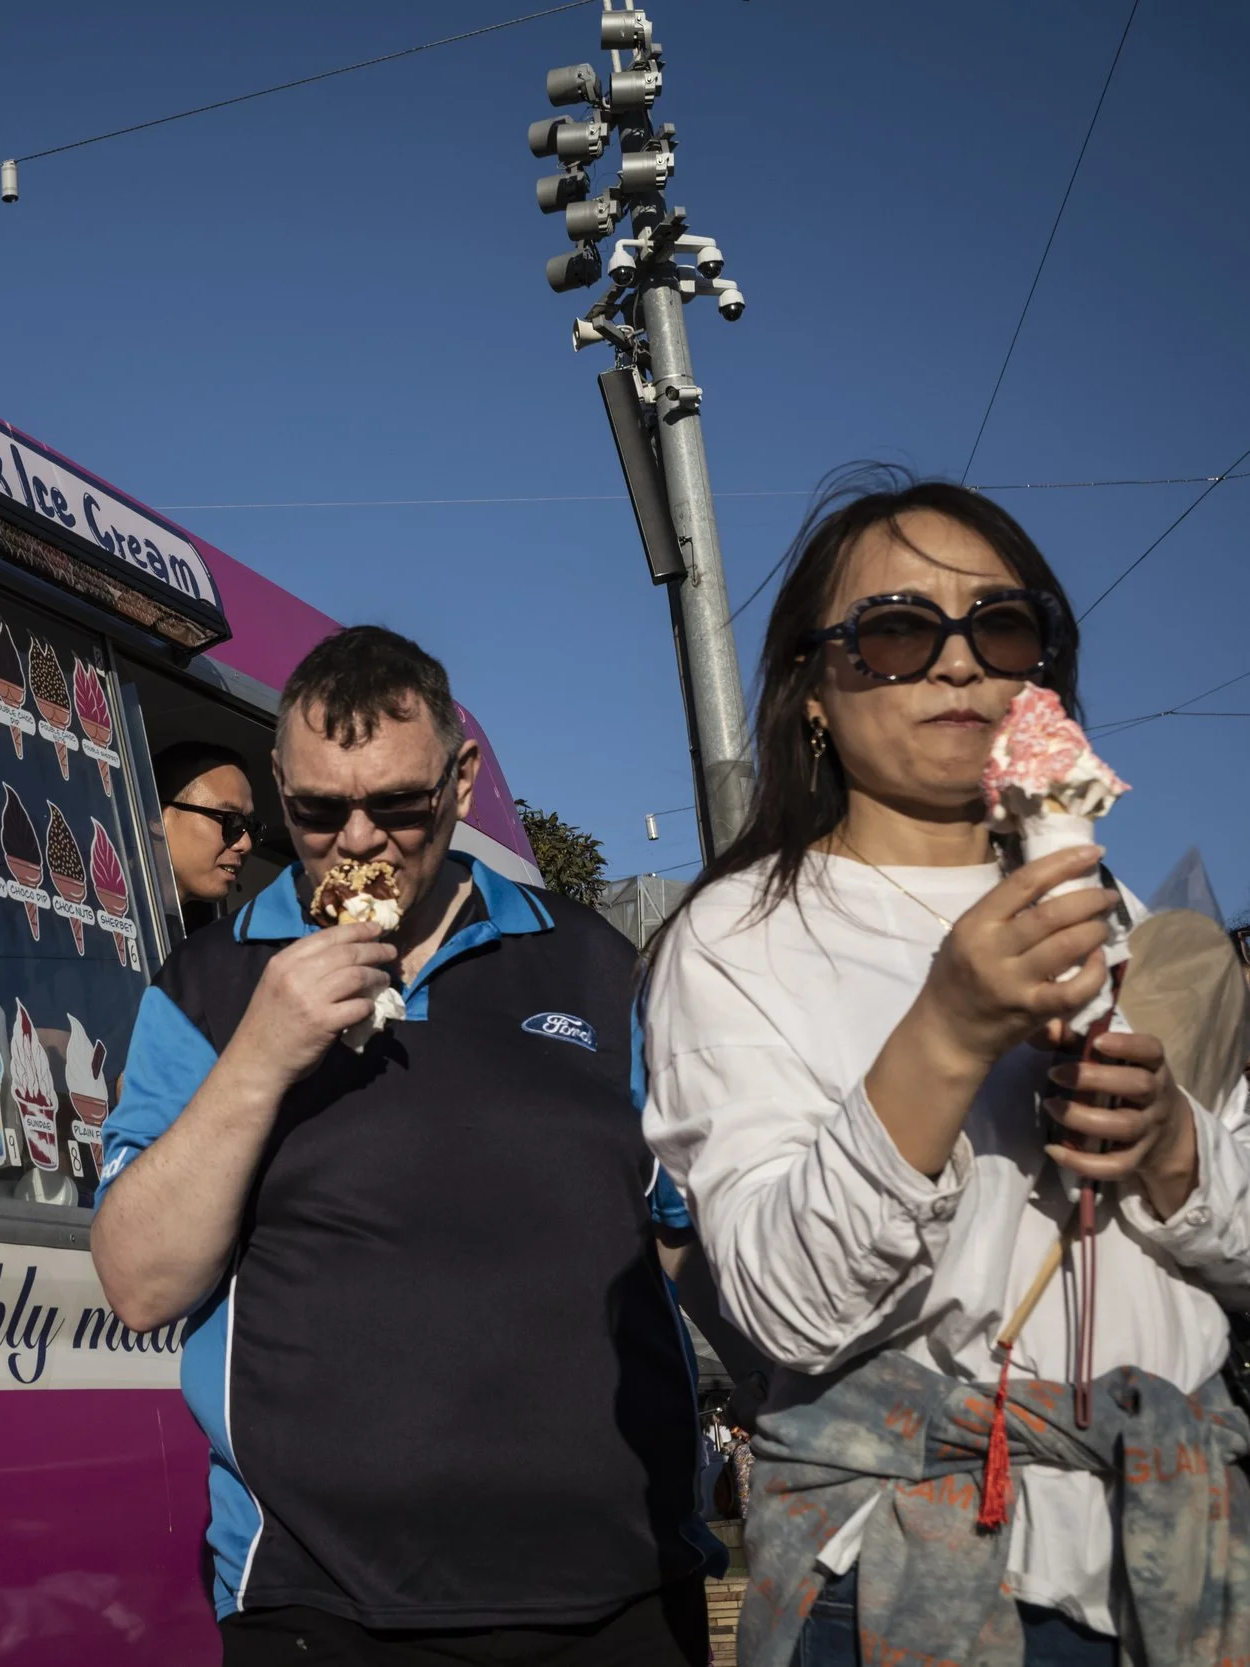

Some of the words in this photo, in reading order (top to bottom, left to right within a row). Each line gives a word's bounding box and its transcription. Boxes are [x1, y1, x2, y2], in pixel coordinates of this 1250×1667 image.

[9, 443, 76, 528] Ice
[83, 492, 201, 600] Cream
[10, 717, 20, 726] DIP
[17, 711, 34, 725] CHOC
[40, 721, 62, 737] DOUBLE
[10, 885, 35, 899] CHOCO
[36, 893, 48, 904] DIP
[54, 900, 75, 915] CHOC
[75, 907, 93, 920] NUTS
[100, 915, 133, 933] SHERBET
[130, 944, 137, 963] 6
[542, 1014, 593, 1044] Ford
[26, 1118, 52, 1131] SUNDAE
[73, 1125, 95, 1138] PLAIN
[8, 1135, 17, 1159] 9
[71, 1147, 82, 1171] 8
